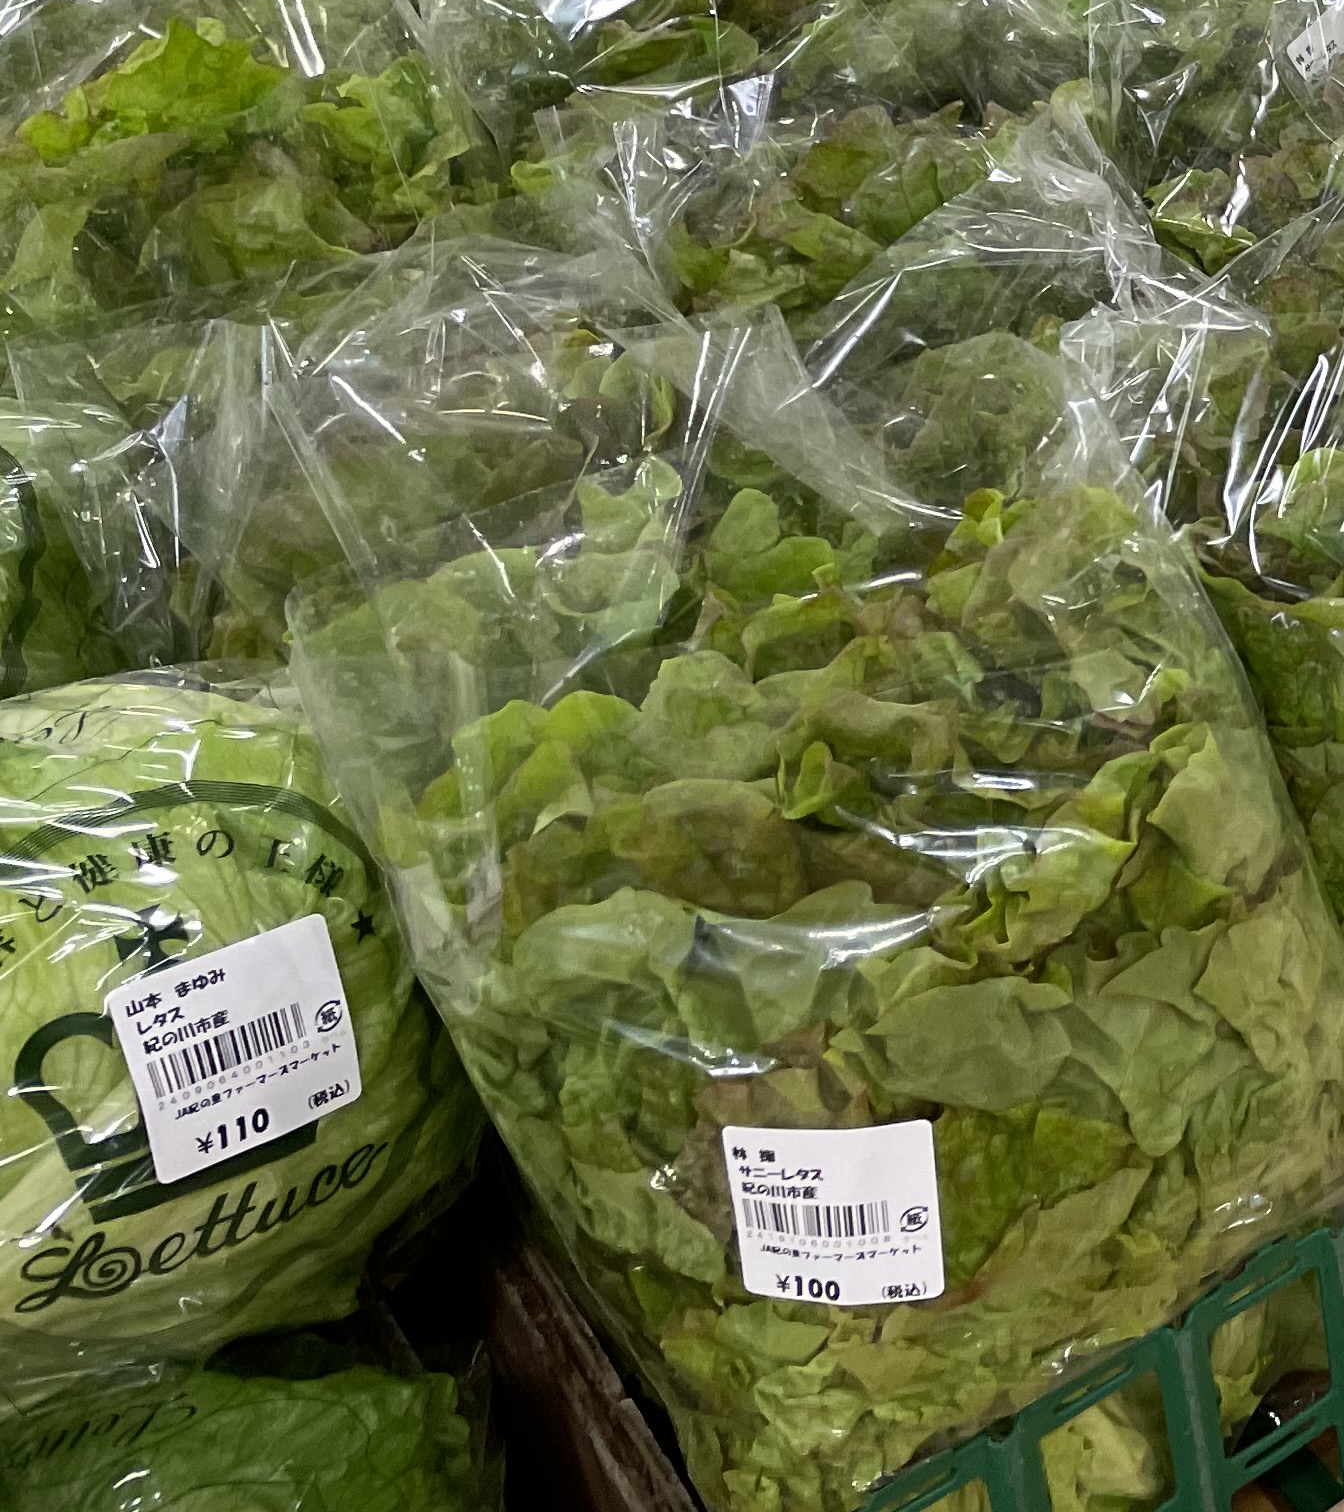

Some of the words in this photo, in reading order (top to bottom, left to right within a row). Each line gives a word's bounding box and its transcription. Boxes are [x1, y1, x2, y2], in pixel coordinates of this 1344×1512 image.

[125, 991, 163, 1018] 山本
[174, 967, 227, 999] まゆみ
[136, 1006, 185, 1036] レタス
[143, 1009, 231, 1056] 紀の川市産
[174, 1042, 342, 1121] JA紀の里ファーマースマーケット
[308, 1079, 351, 1111] (税込)
[195, 1107, 270, 1155] ¥110
[738, 1165, 824, 1182] サニーレタス
[742, 1181, 819, 1199] 紀の川市産
[15, 1141, 390, 1314] Lettuce
[775, 1273, 841, 1302] ¥100
[881, 1281, 928, 1300] (税込)
